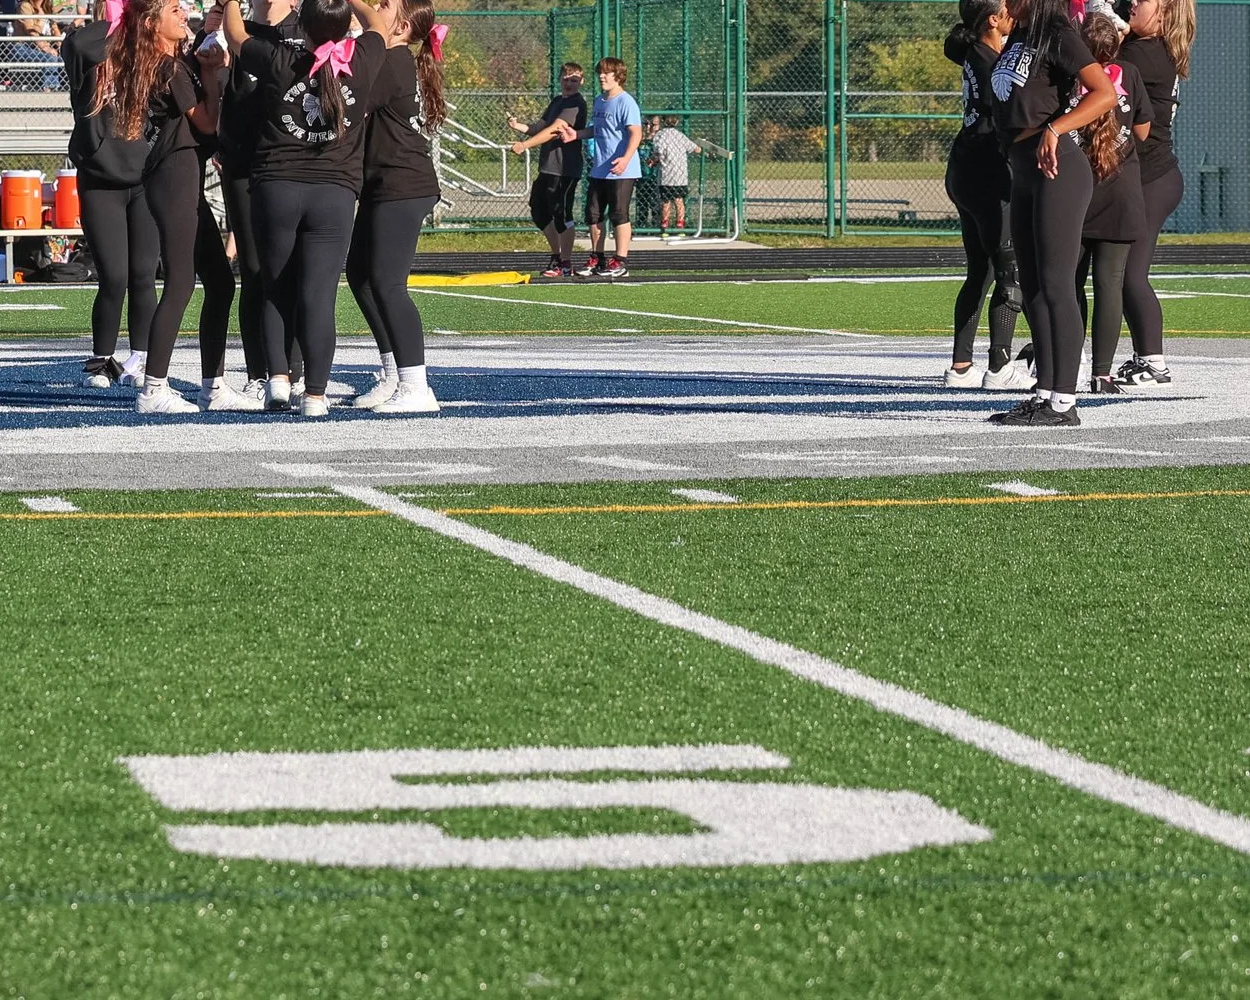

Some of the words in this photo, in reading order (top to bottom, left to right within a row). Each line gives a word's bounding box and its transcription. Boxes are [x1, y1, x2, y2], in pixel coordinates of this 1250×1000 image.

[283, 81, 307, 103] TWO
[310, 78, 356, 106] SOLS
[281, 114, 306, 140] ONE
[307, 117, 352, 143] HEAT
[115, 743, 993, 869] 5
